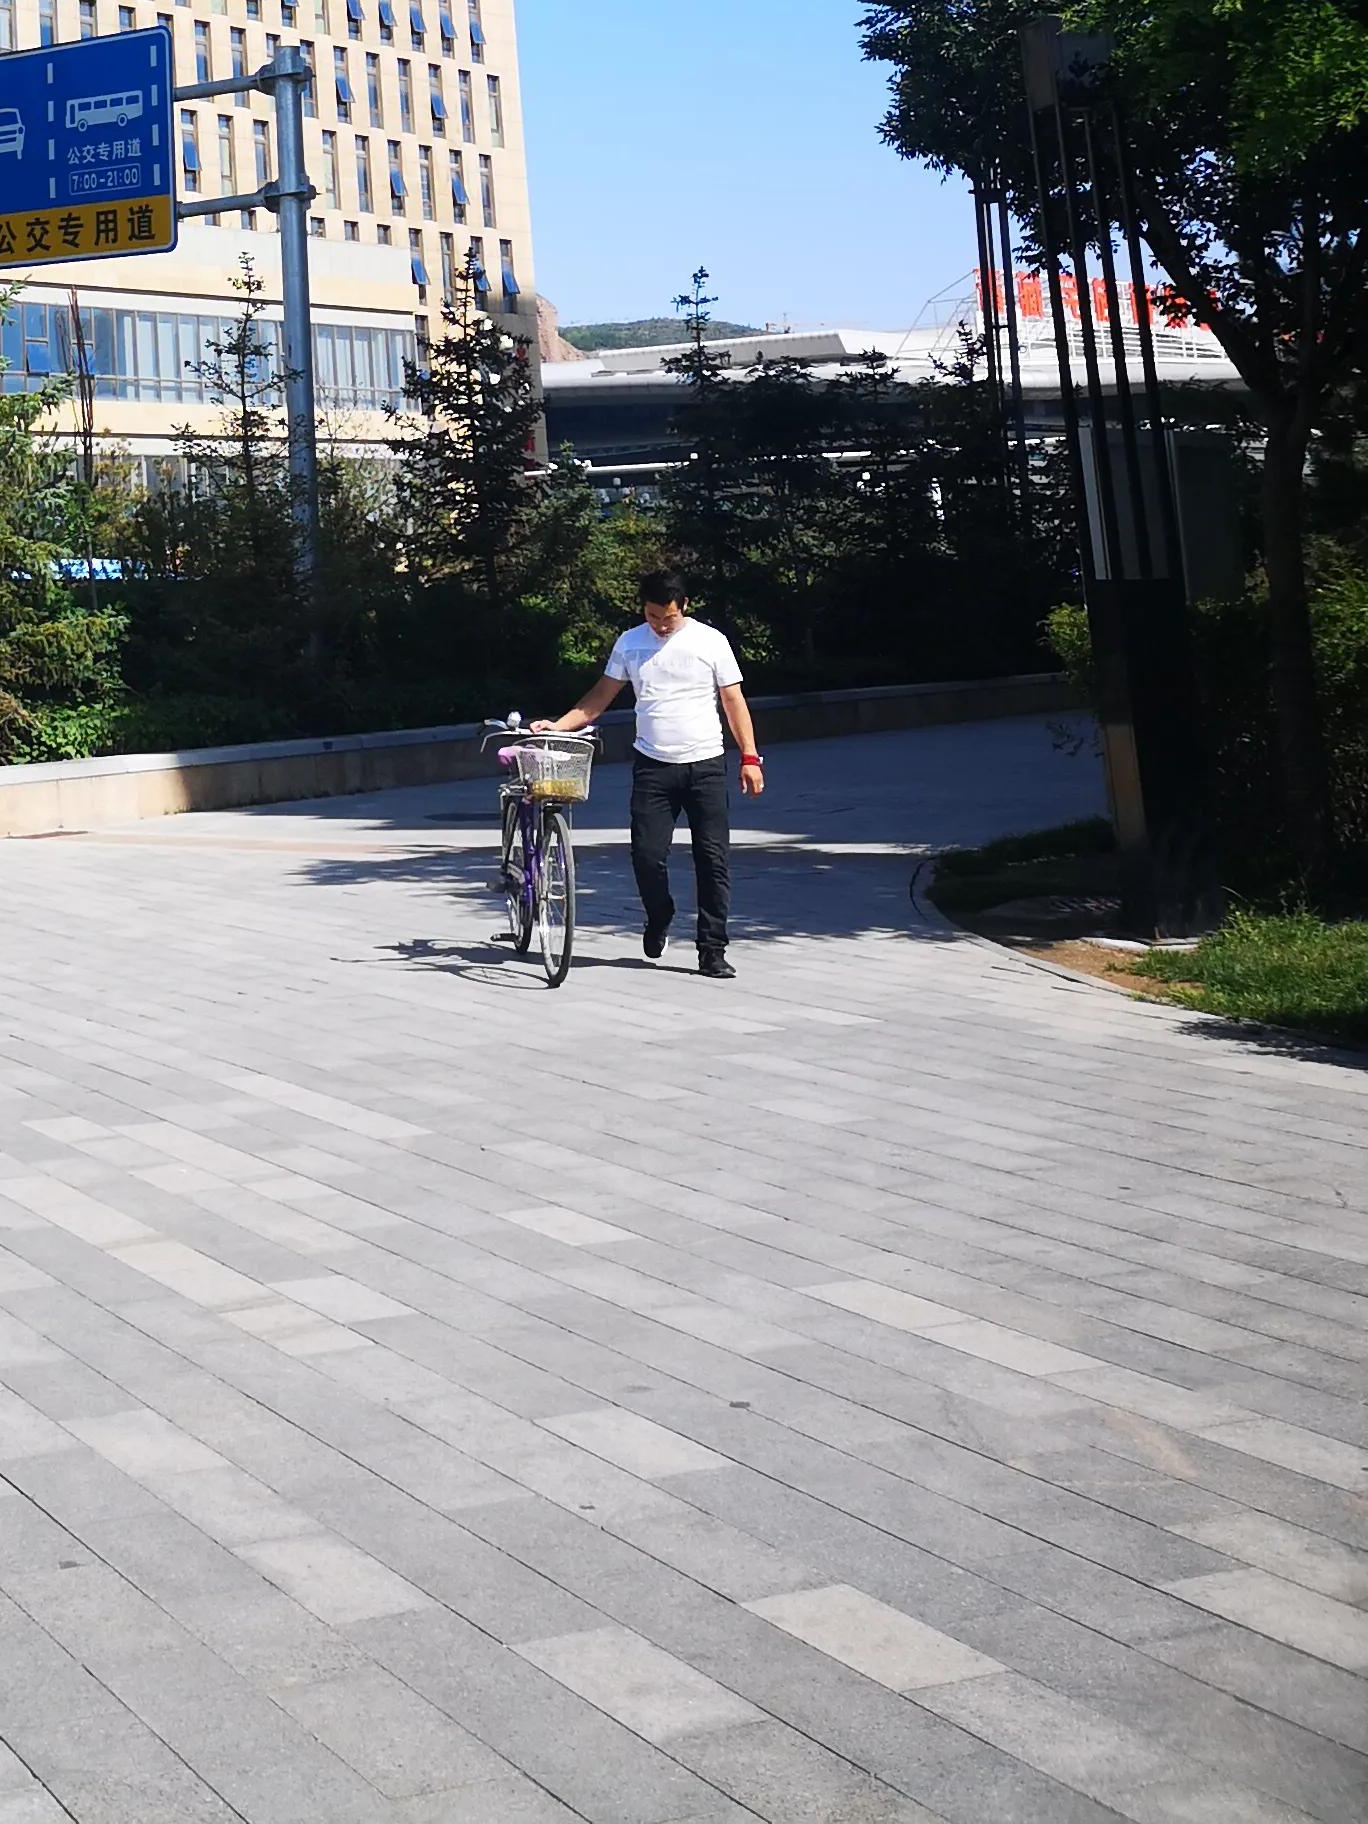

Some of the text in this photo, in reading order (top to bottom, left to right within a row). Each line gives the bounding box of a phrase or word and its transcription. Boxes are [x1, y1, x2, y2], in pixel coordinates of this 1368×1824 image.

[67, 138, 142, 164] 公交专用道
[72, 168, 138, 191] 7:00-21:00
